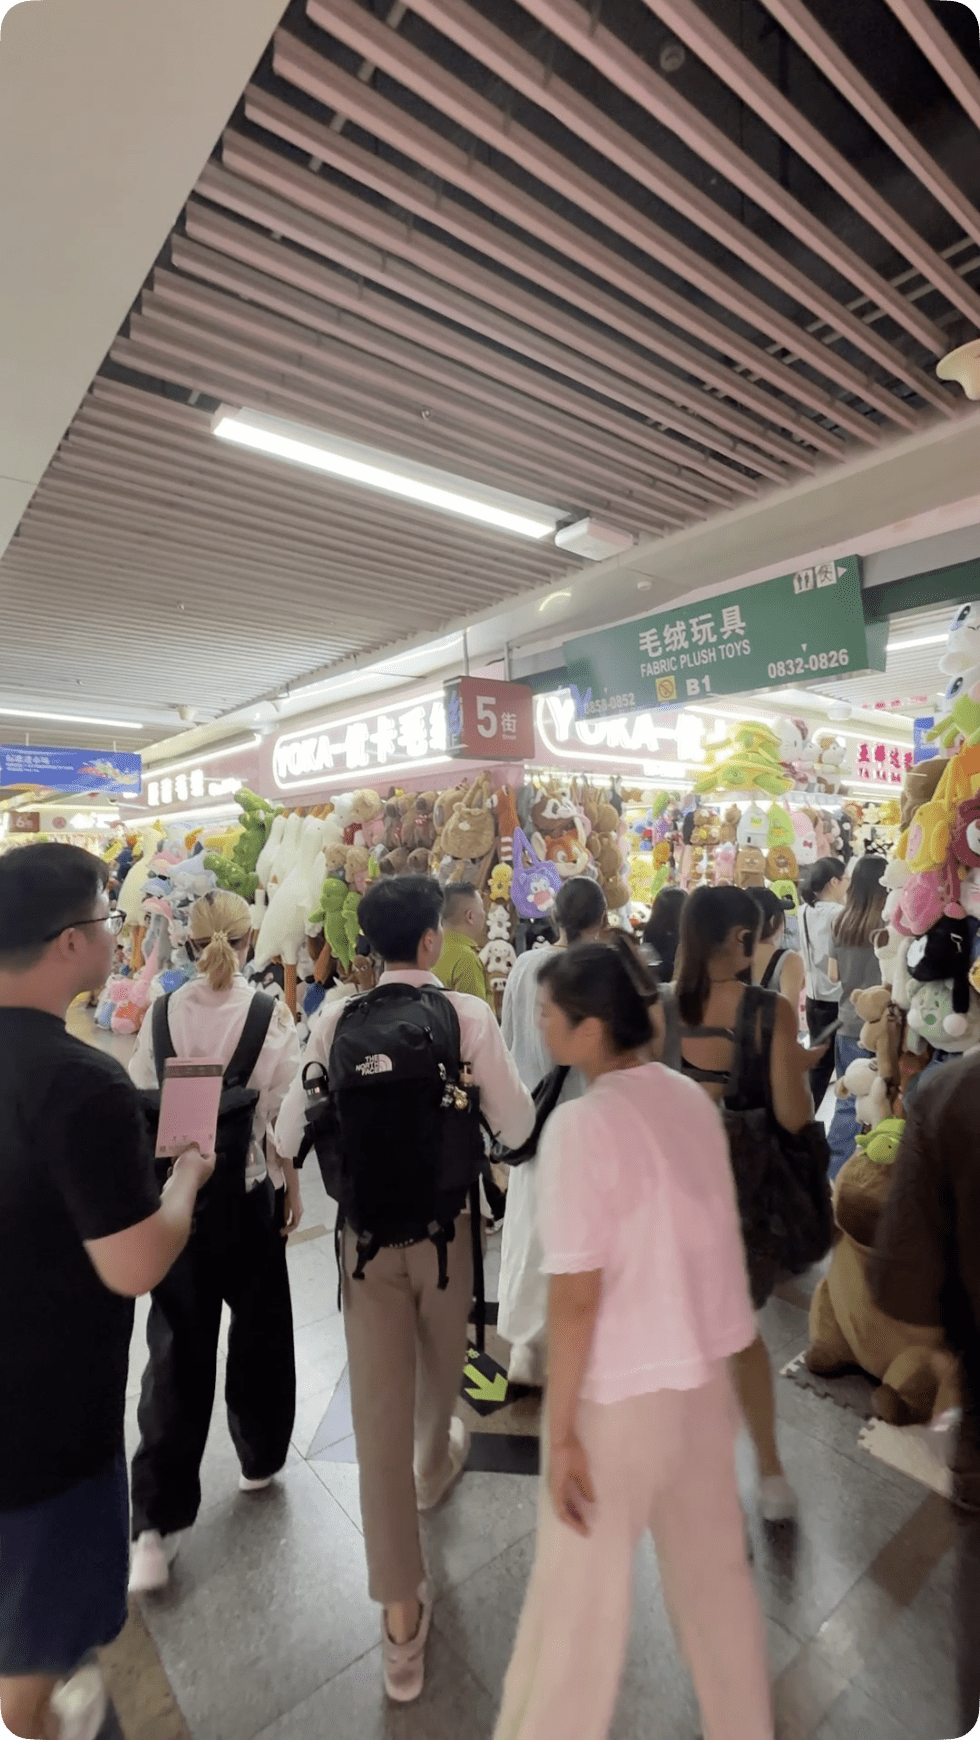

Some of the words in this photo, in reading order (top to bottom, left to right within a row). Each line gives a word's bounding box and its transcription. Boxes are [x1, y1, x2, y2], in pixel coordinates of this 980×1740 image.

[639, 605, 746, 657] 毛绒玩具
[640, 657, 678, 678] FABRIC
[680, 647, 717, 669] PLUSH
[718, 639, 751, 660] TOYS
[767, 648, 850, 679] 0832-0826
[686, 675, 711, 696] B1
[355, 1060, 379, 1071] NORTH
[365, 1055, 379, 1064] THE
[361, 1066, 379, 1076] FACE
